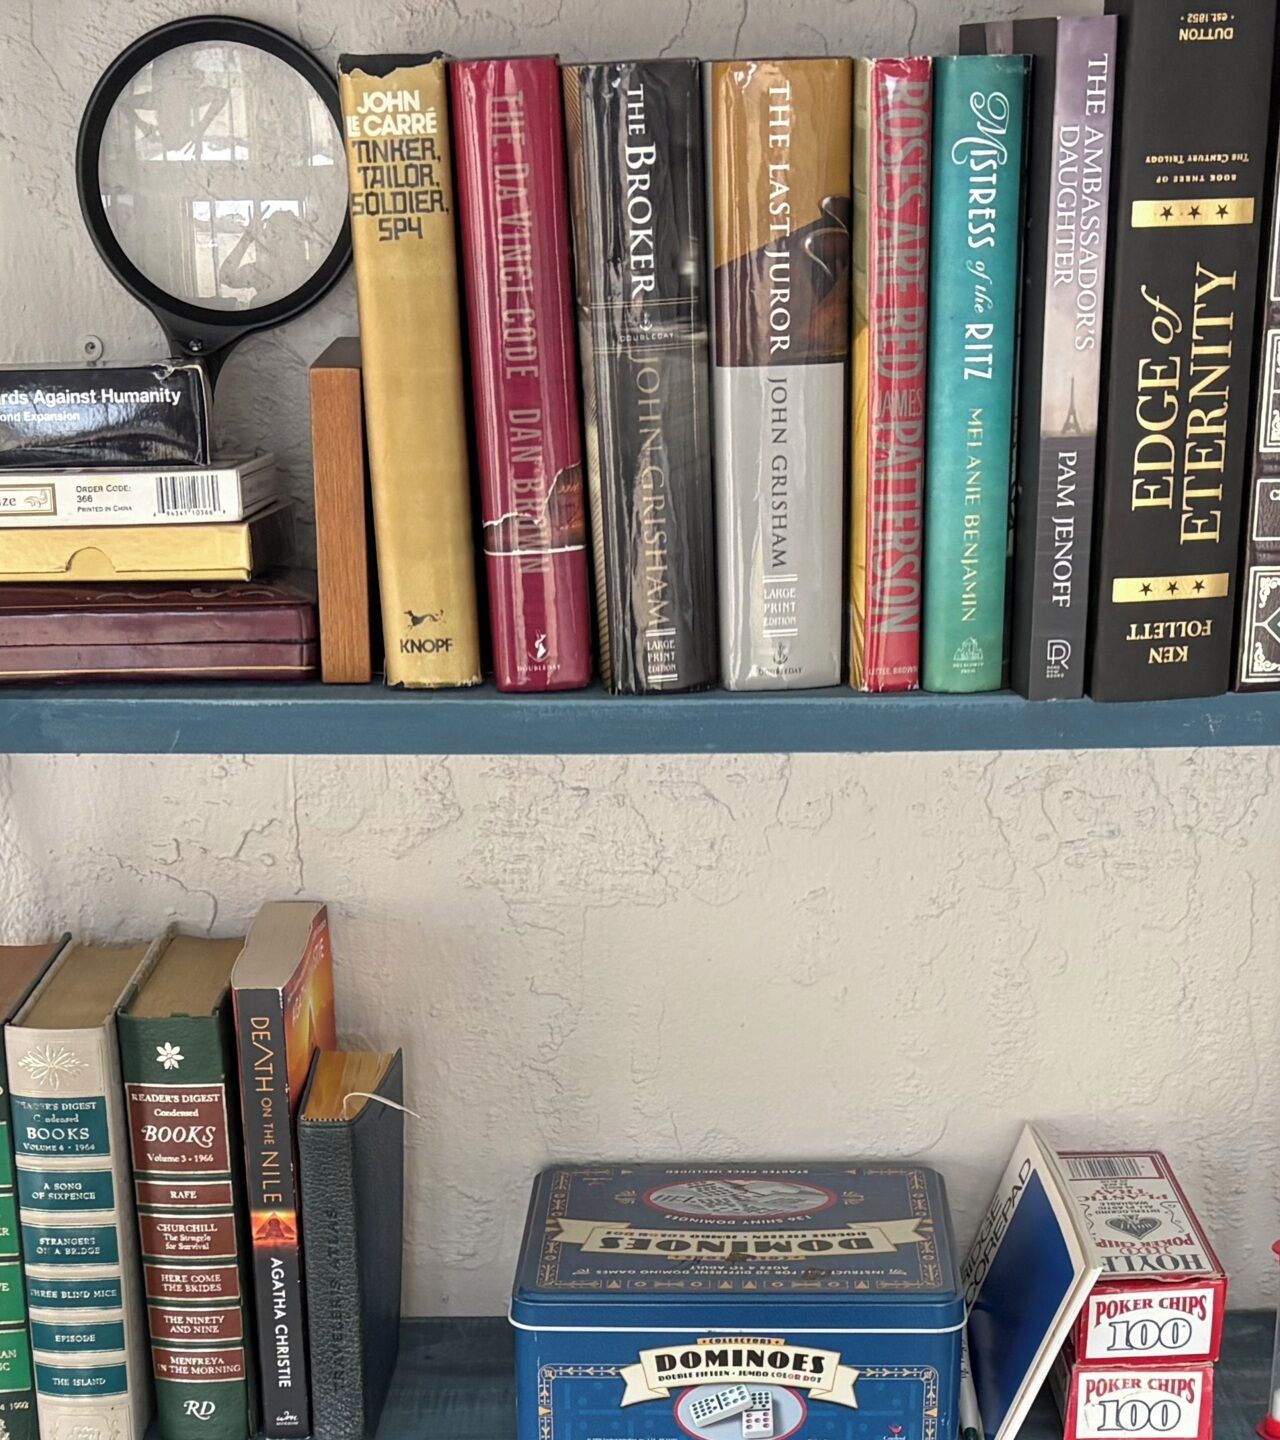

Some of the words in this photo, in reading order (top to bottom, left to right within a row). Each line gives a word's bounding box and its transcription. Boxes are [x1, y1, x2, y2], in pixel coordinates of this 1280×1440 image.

[1179, 27, 1234, 41] DUTTON
[356, 89, 420, 114] JOHN
[627, 83, 646, 136] THE
[1085, 53, 1109, 117] THE
[347, 115, 361, 137] LE
[363, 107, 437, 136] CARRÉ
[489, 90, 525, 148] THE
[768, 80, 790, 148] THE
[352, 138, 441, 163] TINKER,
[879, 80, 930, 210] ROSES
[951, 90, 1010, 249] MISTRESS
[352, 190, 449, 216] SOLDIER,
[494, 162, 530, 200] DA
[769, 163, 790, 237] LAST
[1054, 126, 1080, 288] DAUGHTER
[378, 217, 423, 241] SPY
[625, 141, 657, 300] BROKER
[1075, 126, 1105, 351] AMBASSADOR'S
[497, 210, 534, 293] VINCI
[878, 218, 928, 294] ARE
[967, 260, 993, 285] of
[764, 251, 790, 354] JUROR
[973, 286, 994, 314] the
[1140, 284, 1183, 347] of
[501, 308, 539, 379] CODE
[877, 306, 926, 379] RED
[963, 323, 994, 380] RITZ
[33, 389, 98, 407] Against
[101, 388, 181, 405] Humanity
[768, 377, 788, 444] JOHN
[876, 388, 922, 417] JAMES
[1179, 261, 1238, 546] ETERNITY
[509, 408, 542, 464] DAN
[964, 408, 983, 506] MELANIE
[1131, 356, 1181, 511] EDGE
[76, 485, 104, 493] ORDER
[106, 484, 131, 493] CODE:
[76, 495, 93, 503] 366
[1056, 451, 1077, 508] PAM
[511, 478, 551, 574] BROWN
[770, 455, 788, 568] GRISHAM
[871, 421, 923, 633] PATTERSON
[960, 515, 981, 622] BENJAMIN
[1051, 516, 1075, 608] JENOFF
[399, 637, 454, 654] KNOPF
[1126, 619, 1213, 641] FOLLETT
[1148, 646, 1189, 665] KEN
[250, 1016, 274, 1093] DEATH
[26, 1128, 90, 1140] BOOKS
[261, 1096, 273, 1118] ON
[262, 1122, 275, 1146] THE
[141, 1125, 216, 1148] BOOKS
[170, 1191, 197, 1199] RAFE
[260, 1151, 282, 1204] NILE
[156, 1224, 218, 1232] CHURCHILL
[270, 1257, 287, 1320] AGATHA
[1095, 1298, 1154, 1328] POKER
[1158, 1295, 1207, 1321] CHIPS
[274, 1323, 292, 1388] CHRISTIE
[655, 1349, 825, 1374] DOMINOES
[1107, 1318, 1192, 1351] 100
[1085, 1378, 1141, 1404] POKER
[1147, 1377, 1196, 1404] CHIPS
[1097, 1400, 1181, 1431] 100
